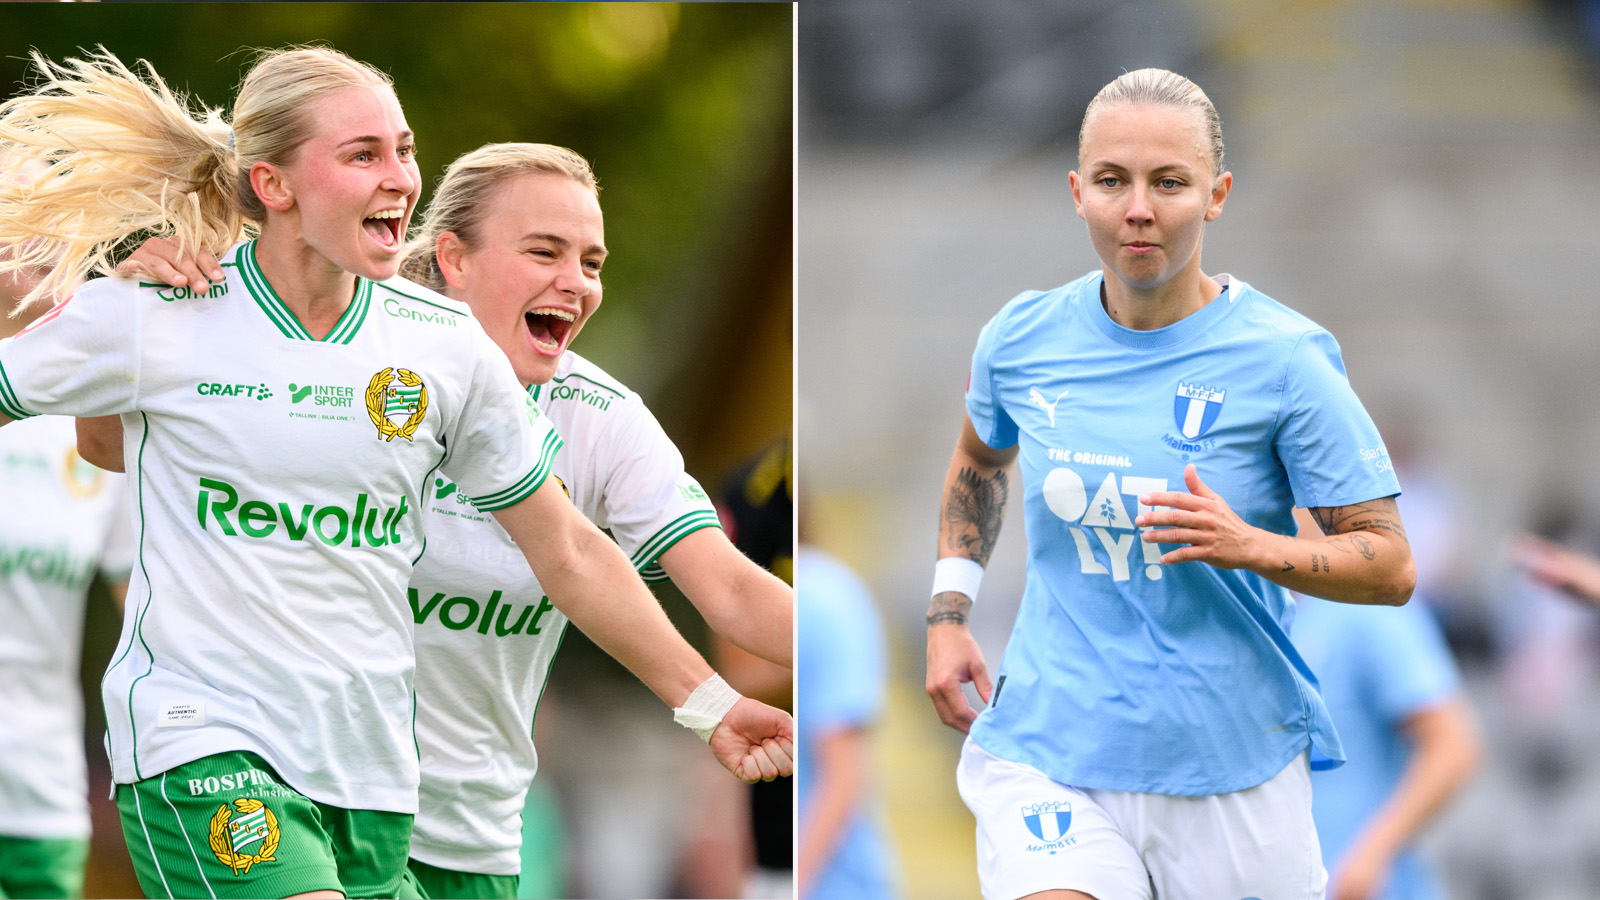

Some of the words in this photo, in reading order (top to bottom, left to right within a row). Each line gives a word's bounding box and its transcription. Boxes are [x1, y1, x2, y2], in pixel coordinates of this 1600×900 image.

[383, 298, 457, 327] Convini
[197, 382, 257, 398] CRAFT
[314, 384, 354, 397] INTER
[314, 395, 354, 408] SPORT
[1161, 432, 1202, 453] Malmö
[1202, 437, 1217, 450] FF
[1048, 447, 1072, 462] THE
[1073, 451, 1133, 468] ORIGINAL
[1042, 467, 1169, 530] OAT
[197, 476, 409, 548] Revolut
[407, 587, 554, 637] volut
